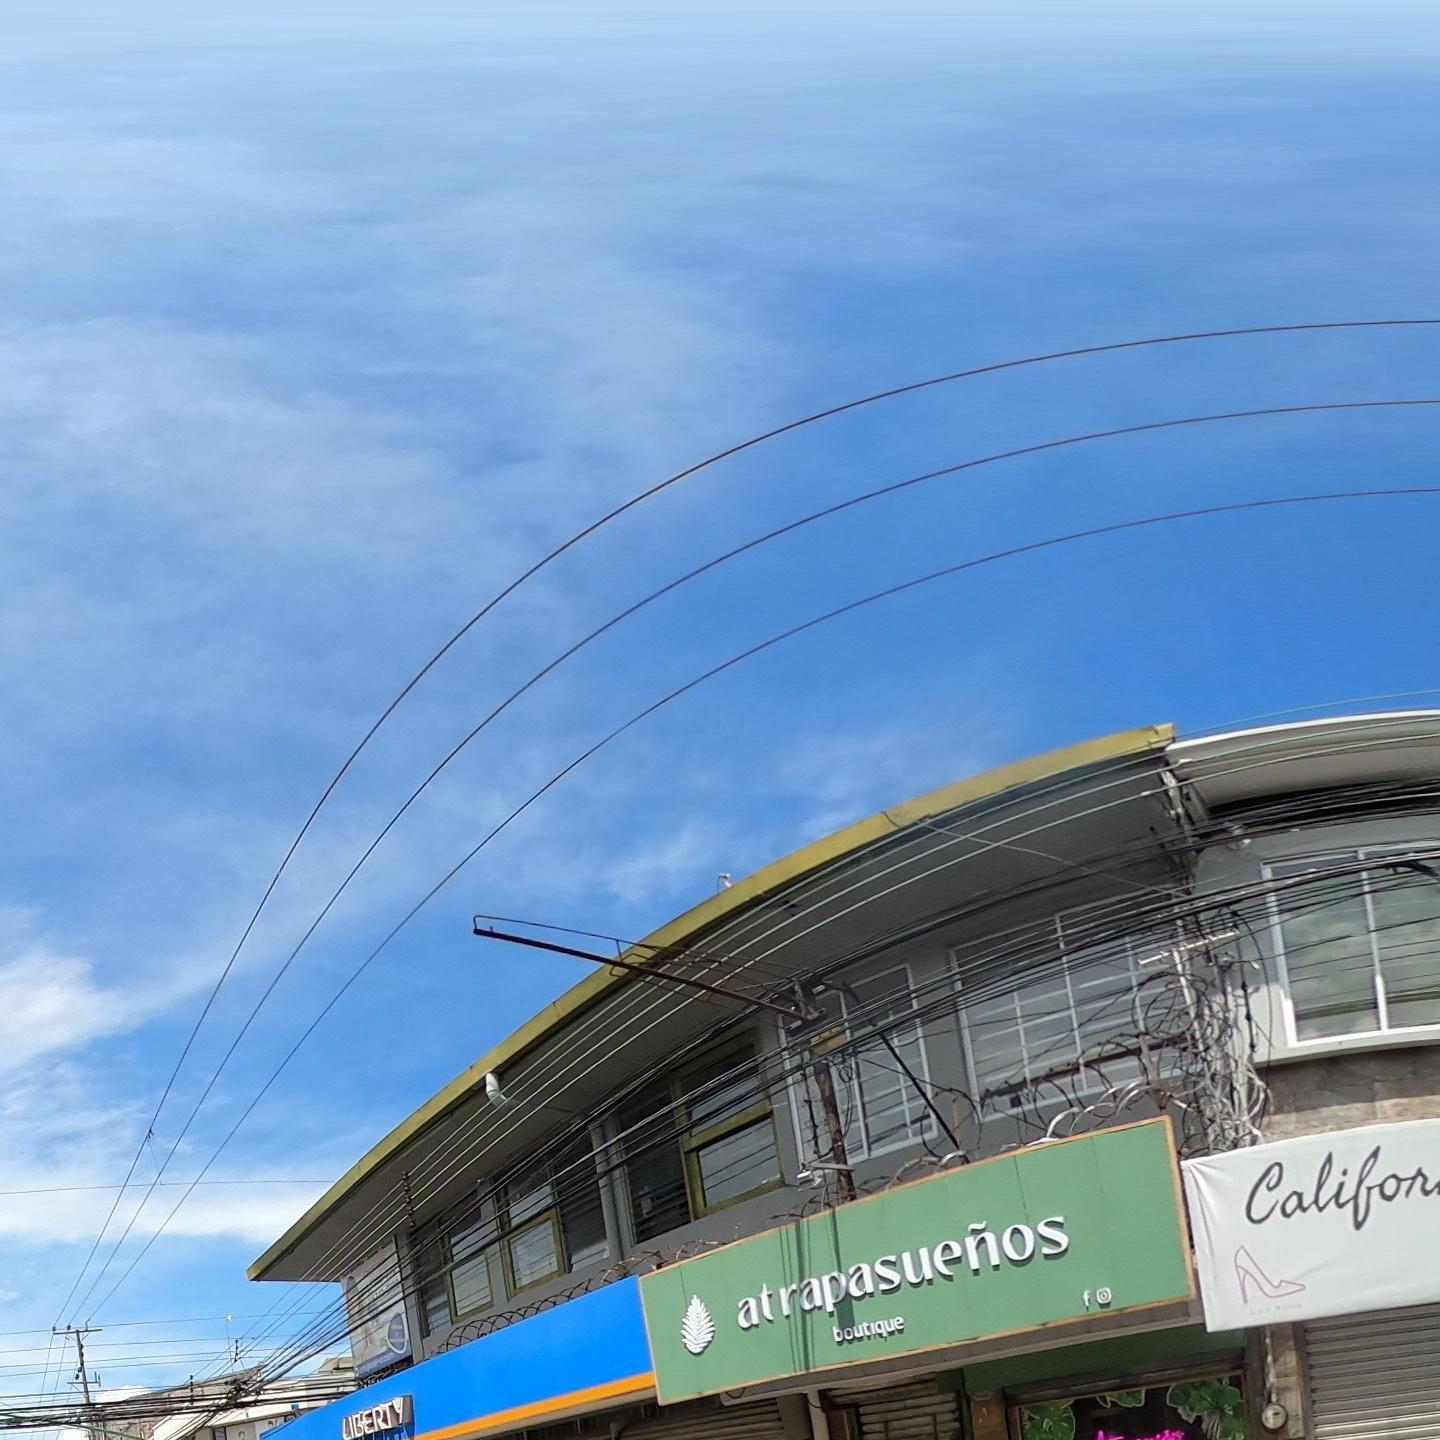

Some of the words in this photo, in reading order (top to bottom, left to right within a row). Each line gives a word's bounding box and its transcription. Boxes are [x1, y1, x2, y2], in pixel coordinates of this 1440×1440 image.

[737, 1216, 1070, 1330] atrapasueños
[833, 1315, 905, 1344] boutique
[342, 1396, 406, 1440] LIBERTY
